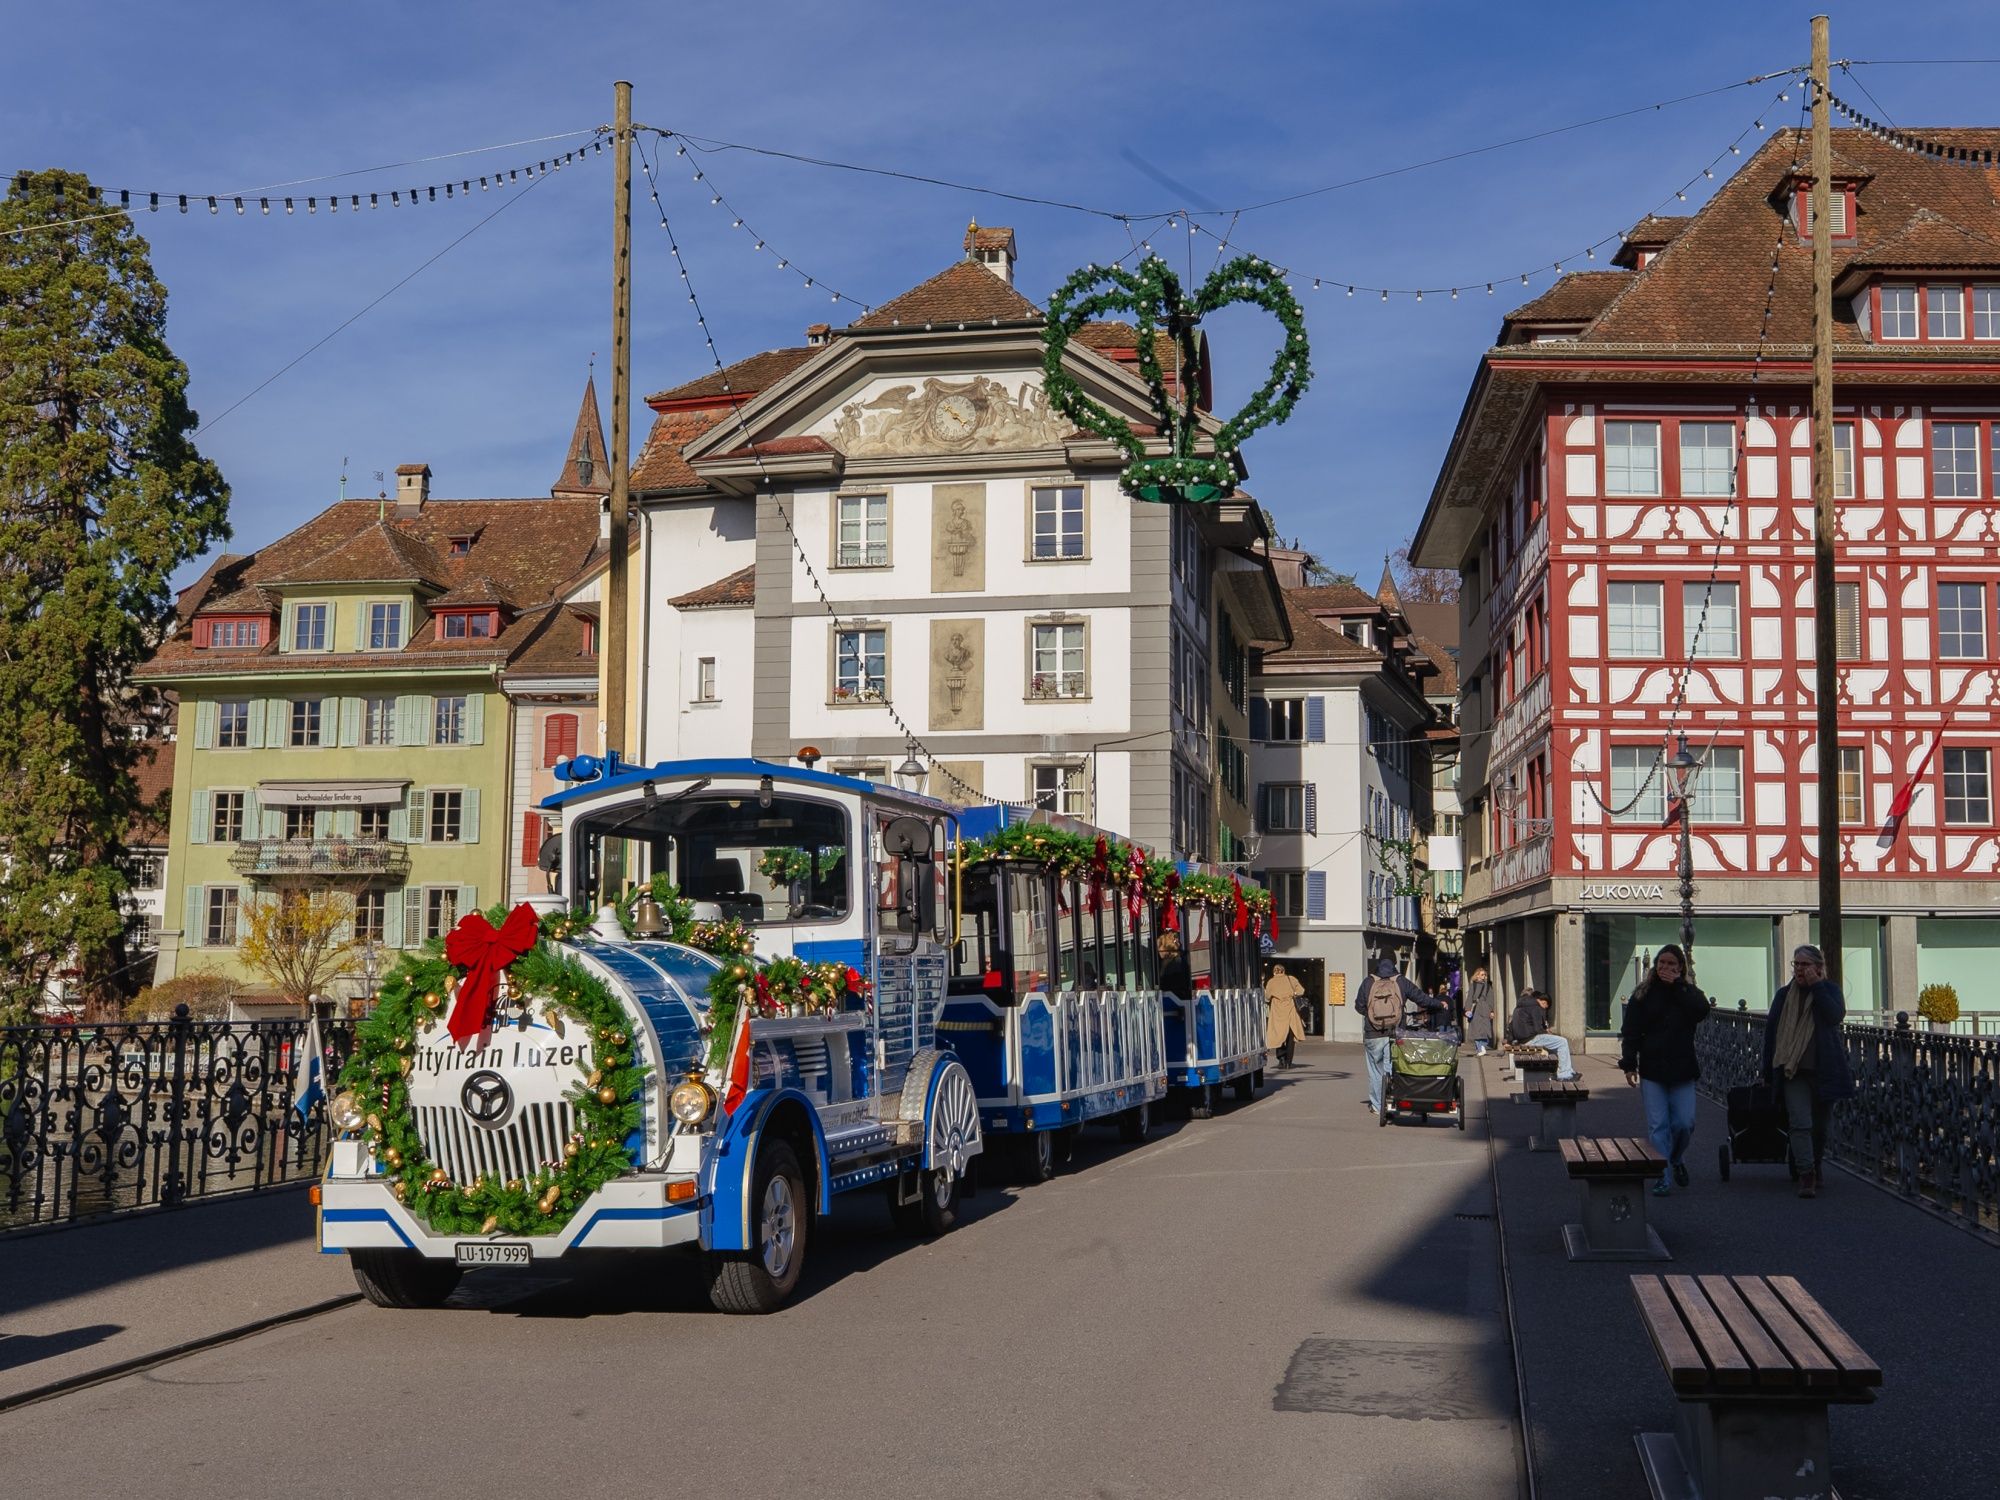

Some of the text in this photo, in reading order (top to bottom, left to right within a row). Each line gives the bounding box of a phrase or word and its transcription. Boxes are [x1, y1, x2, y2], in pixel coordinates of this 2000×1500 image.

[296, 793, 333, 801] buchwalder
[334, 793, 352, 801] linder
[411, 1046, 503, 1077] ityTrain
